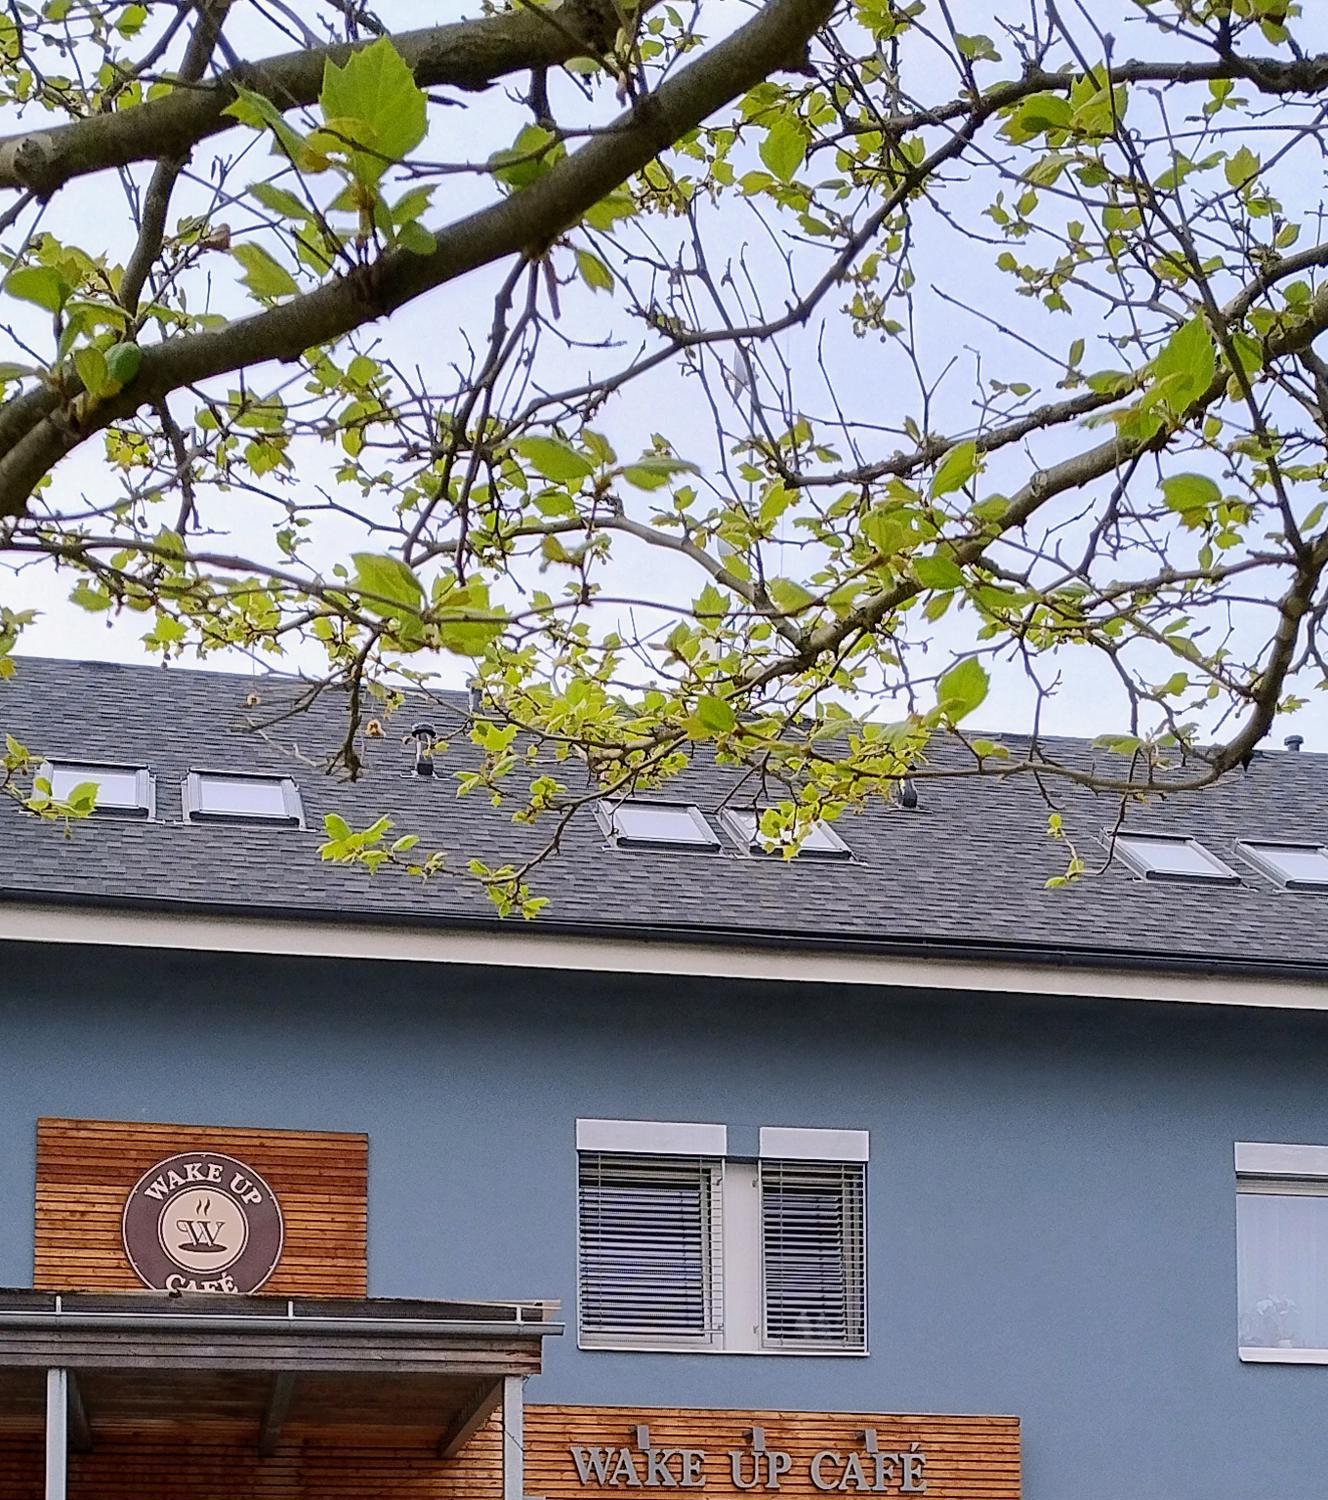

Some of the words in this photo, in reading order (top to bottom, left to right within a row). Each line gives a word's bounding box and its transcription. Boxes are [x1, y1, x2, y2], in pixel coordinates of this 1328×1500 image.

[144, 1162, 223, 1200] WAKE
[230, 1172, 262, 1204] UP
[570, 1446, 706, 1487] WAKE
[728, 1450, 792, 1489] UP
[810, 1442, 928, 1492] CAFÉ
